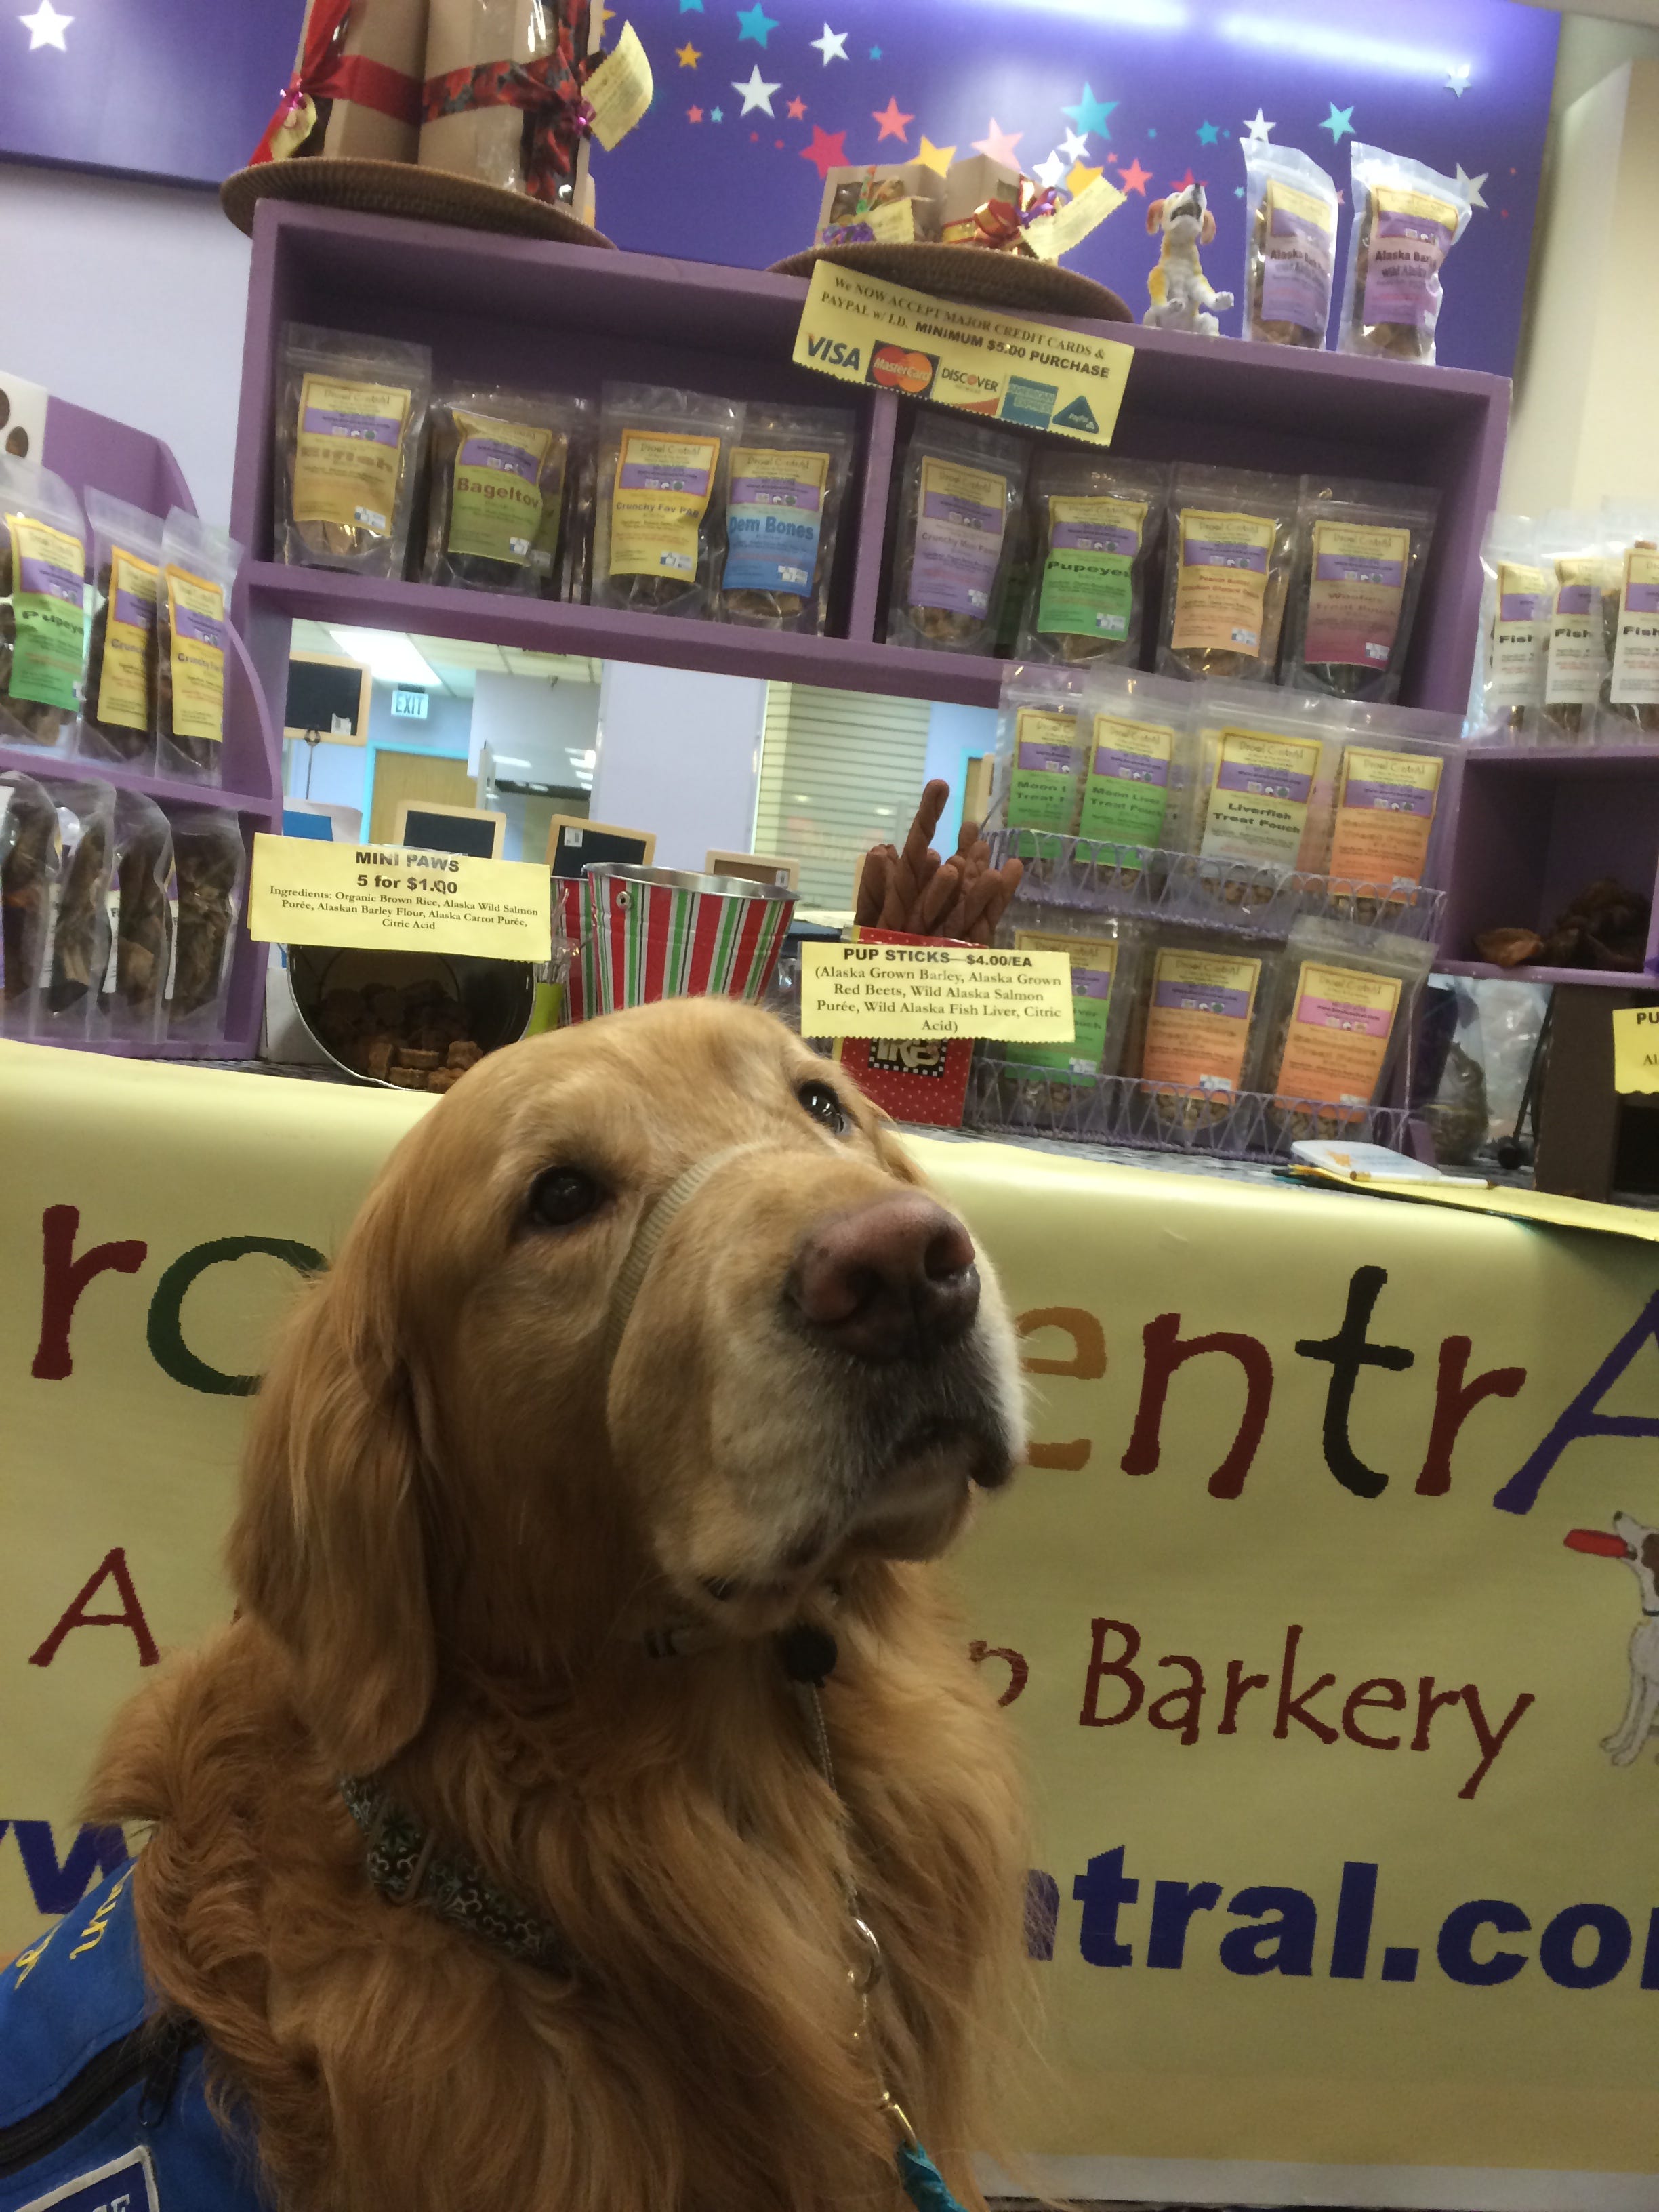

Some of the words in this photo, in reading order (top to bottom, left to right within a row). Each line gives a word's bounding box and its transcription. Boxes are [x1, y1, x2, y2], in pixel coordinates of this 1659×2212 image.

[835, 276, 853, 289] We
[855, 280, 884, 301] NOW
[888, 291, 941, 319] ACCEPT
[945, 308, 991, 331] MAJOR
[994, 321, 1044, 346] CREDIT
[1046, 335, 1092, 356] CARDS
[1094, 347, 1105, 361] &
[821, 290, 869, 317] PAYPAL
[915, 321, 984, 348] MINIMUM
[987, 337, 1026, 361] $5.00
[1029, 350, 1111, 379] PURCHASE
[808, 335, 861, 371] VISA
[874, 356, 932, 382] MasterCard
[941, 367, 999, 393] DISCOVER
[765, 516, 814, 540] Bones
[394, 695, 426, 717] EXIT
[1212, 812, 1254, 825] Treat
[1259, 819, 1300, 834] Pouch
[356, 851, 400, 867] MINI
[406, 853, 460, 873] PAWS
[356, 874, 368, 888] 5
[374, 874, 401, 890] for
[407, 876, 459, 895] $1.00
[270, 885, 333, 901] Ingredients:
[335, 890, 377, 903] Organic
[380, 894, 412, 905] Brown
[415, 897, 441, 909] Rice,
[443, 898, 476, 910] Alaska
[478, 900, 501, 912] Wild
[502, 903, 539, 916] Salmon
[281, 899, 315, 912] Purée,
[317, 901, 358, 913] Alaskan
[361, 905, 393, 918] Barley
[396, 907, 425, 919] Flour,
[428, 909, 462, 921] Alaska
[464, 912, 495, 924] Carrot
[497, 914, 529, 928] Purée,
[382, 918, 410, 929] Citric
[412, 919, 436, 930] Acid
[844, 947, 880, 961] PUP
[815, 966, 865, 980] (Alaska
[869, 967, 915, 980] Grown
[919, 969, 966, 985] Barley,
[968, 971, 1014, 985] Alaska
[1017, 973, 1062, 987] Grown
[834, 983, 861, 996] Red
[865, 984, 907, 999] Beets,
[910, 985, 942, 998] Wild
[946, 986, 990, 1000] Alaska
[994, 987, 1044, 1002] Salmon
[817, 1000, 861, 1015] Purée,
[863, 1000, 896, 1014] Wild
[899, 1002, 945, 1015] Alaska
[949, 1003, 979, 1016] Fish
[983, 1004, 1021, 1019] Liver,
[1023, 1006, 1062, 1019] Citric
[921, 1019, 959, 1033] Acid)
[1078, 1616, 1536, 1800] Barkery
